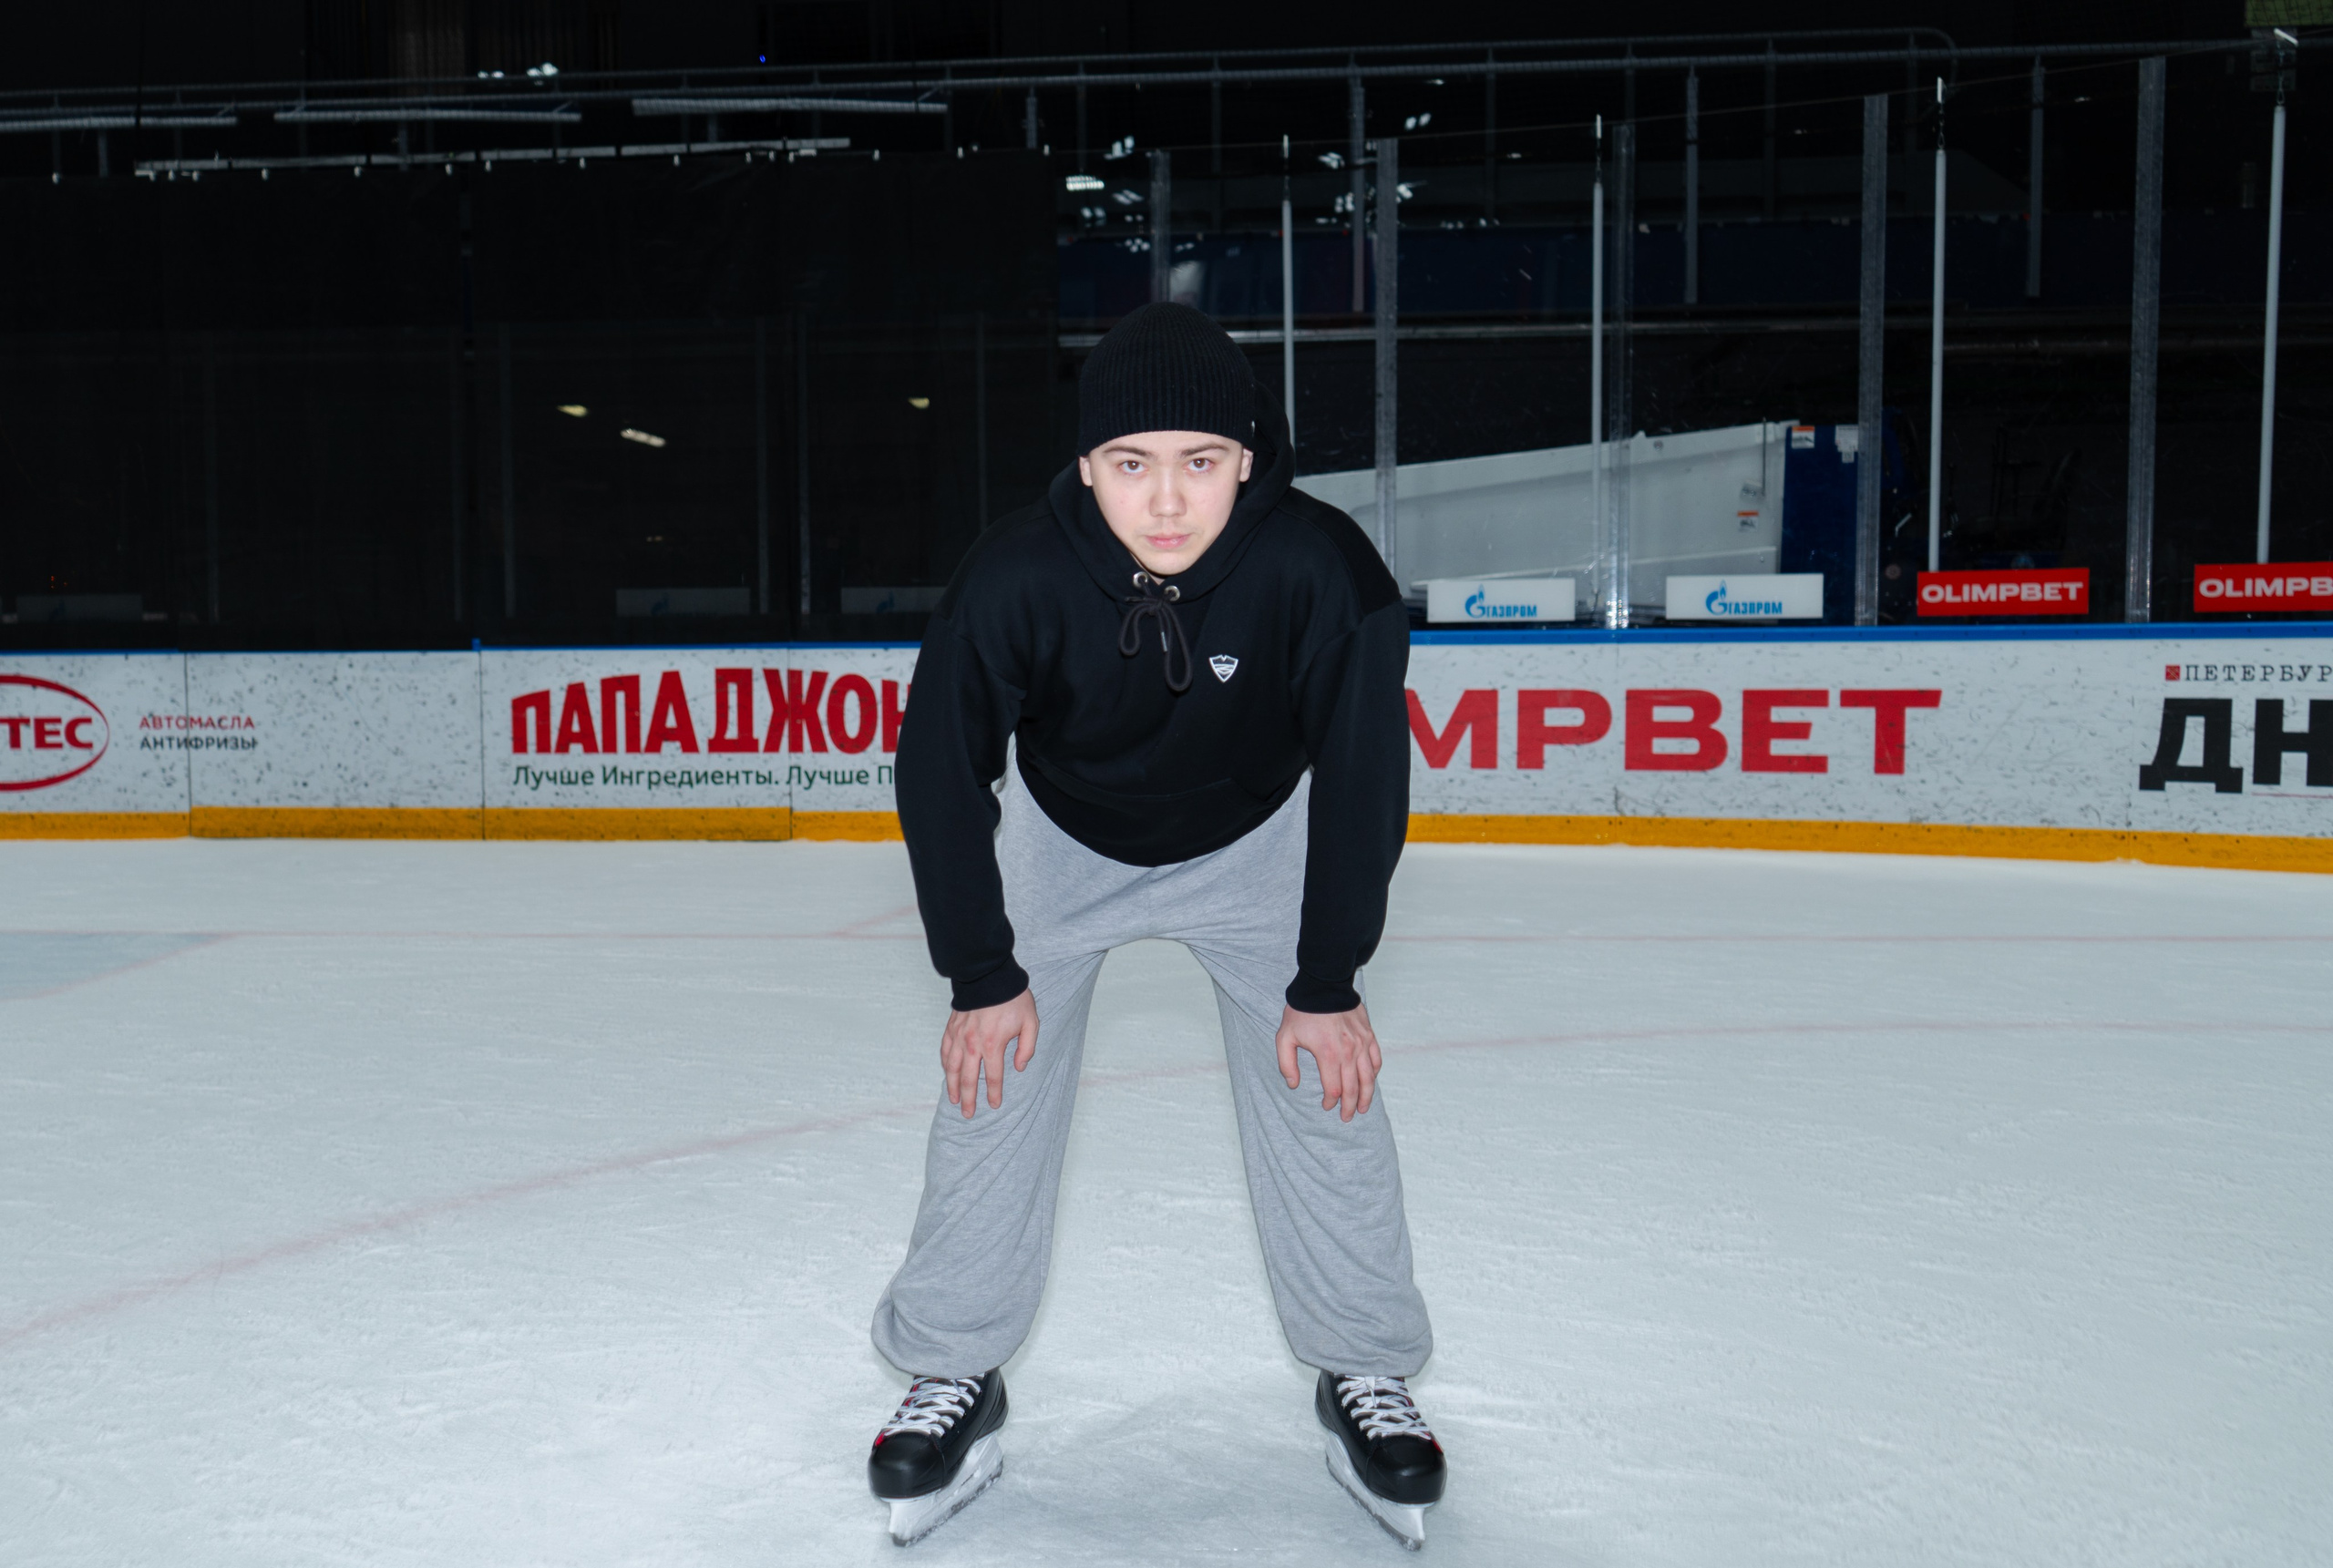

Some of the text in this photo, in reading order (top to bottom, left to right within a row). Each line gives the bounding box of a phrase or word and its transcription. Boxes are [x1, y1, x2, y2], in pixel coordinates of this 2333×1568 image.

[1921, 581, 2084, 603] OLIMPBET
[2185, 664, 2333, 682] ПЕТЕРБУР
[139, 715, 255, 730] АВТОМАСЛА
[511, 670, 700, 754] ПАПА
[140, 735, 259, 751] АНТИФРИЗЫ
[2139, 698, 2333, 794] ДН
[513, 765, 594, 791] Лучше
[602, 764, 779, 791] Ингредиенты.
[786, 765, 869, 791] Лучше
